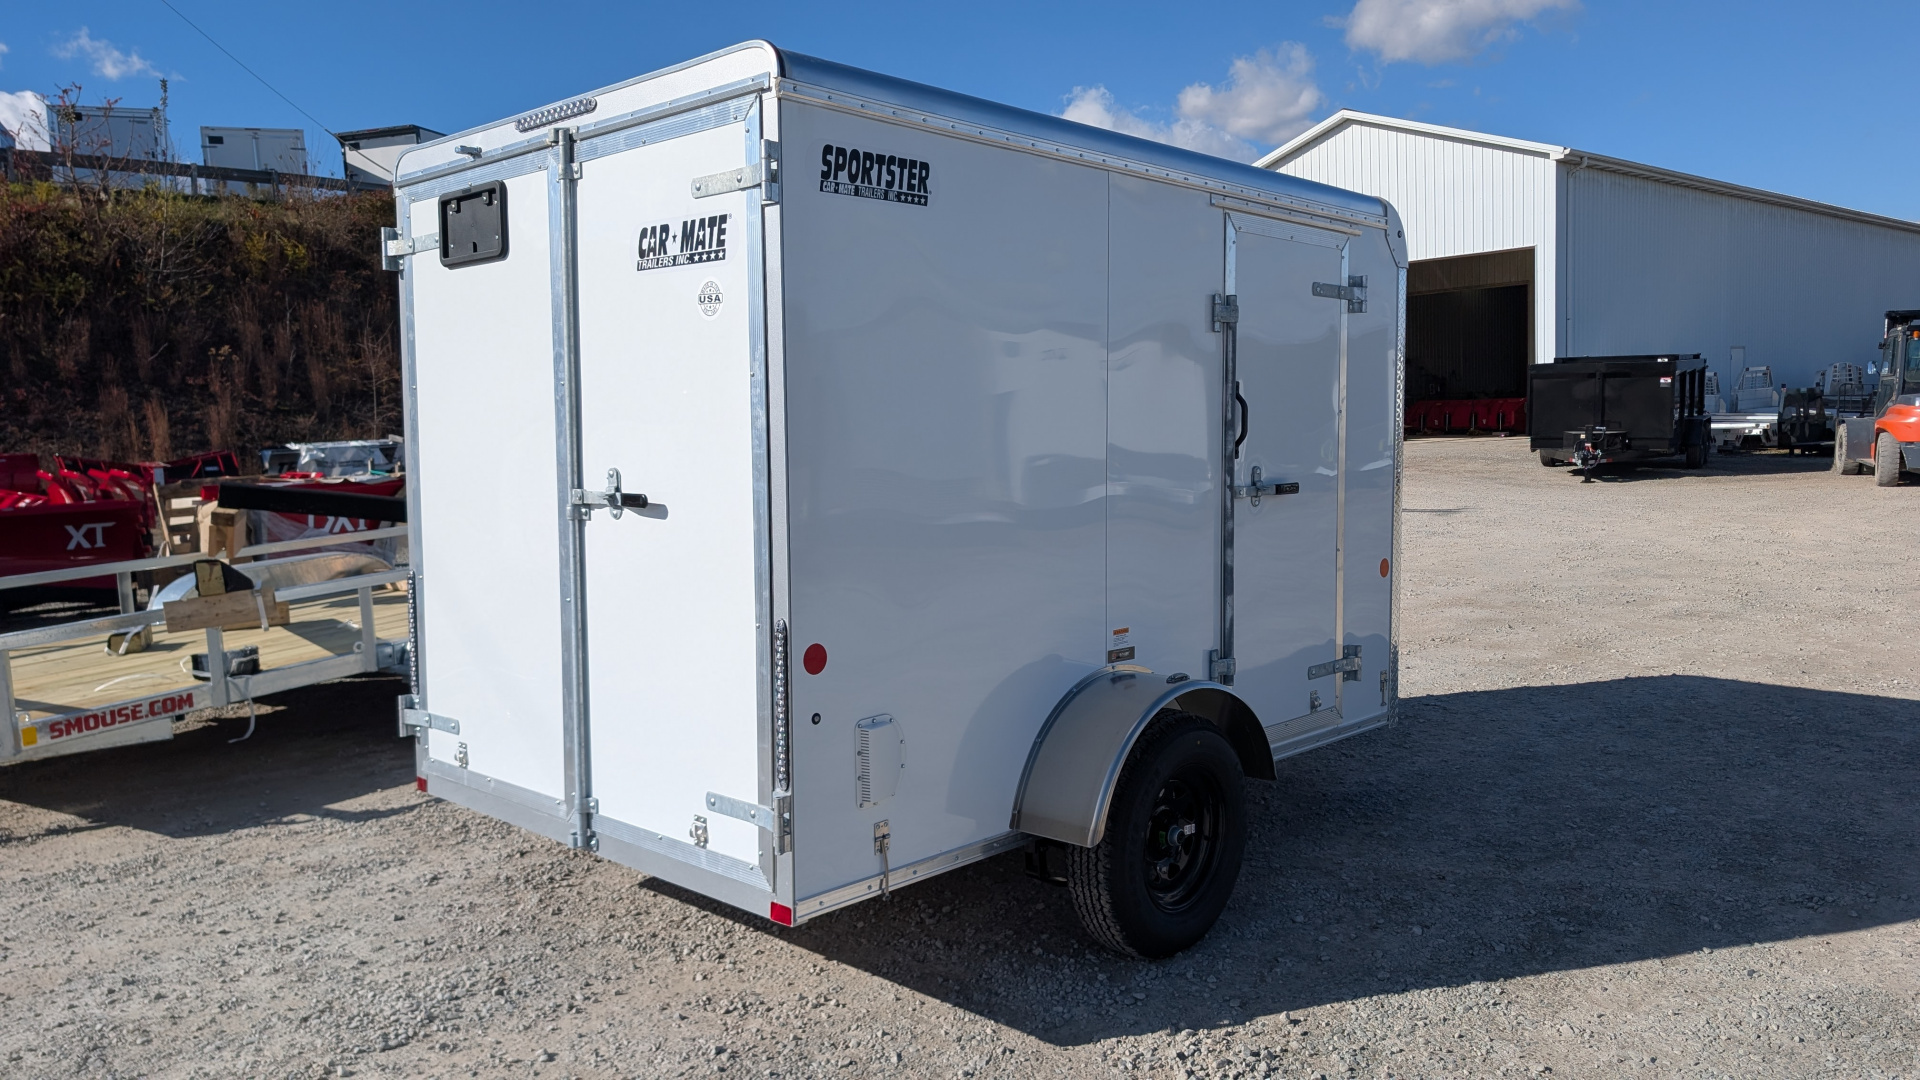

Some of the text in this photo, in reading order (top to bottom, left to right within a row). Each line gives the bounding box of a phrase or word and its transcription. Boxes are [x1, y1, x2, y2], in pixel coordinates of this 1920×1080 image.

[820, 144, 930, 195] SPORTSTER
[822, 181, 835, 193] CAR
[838, 183, 856, 196] MATE
[858, 185, 885, 200] TRAILERS
[638, 213, 728, 260] CAR MATE
[638, 253, 692, 270] TRAILERS INC.
[699, 294, 721, 304] USA
[64, 521, 117, 550] XT
[48, 692, 194, 740] SMOUSE.COM
